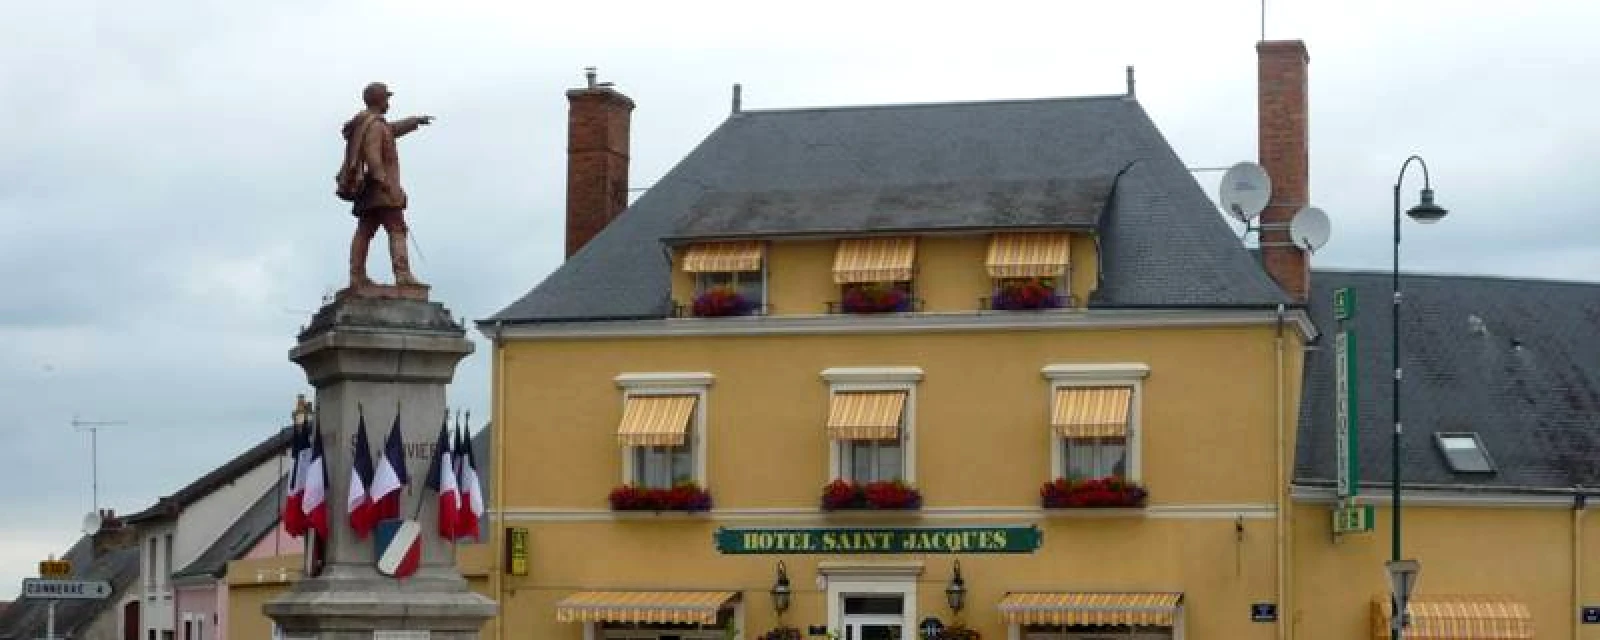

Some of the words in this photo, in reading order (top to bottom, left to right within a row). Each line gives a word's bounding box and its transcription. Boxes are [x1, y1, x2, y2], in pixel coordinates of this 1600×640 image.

[743, 532, 813, 549] HOTEL
[821, 531, 894, 549] SAINT
[903, 530, 1007, 550] JACQUES
